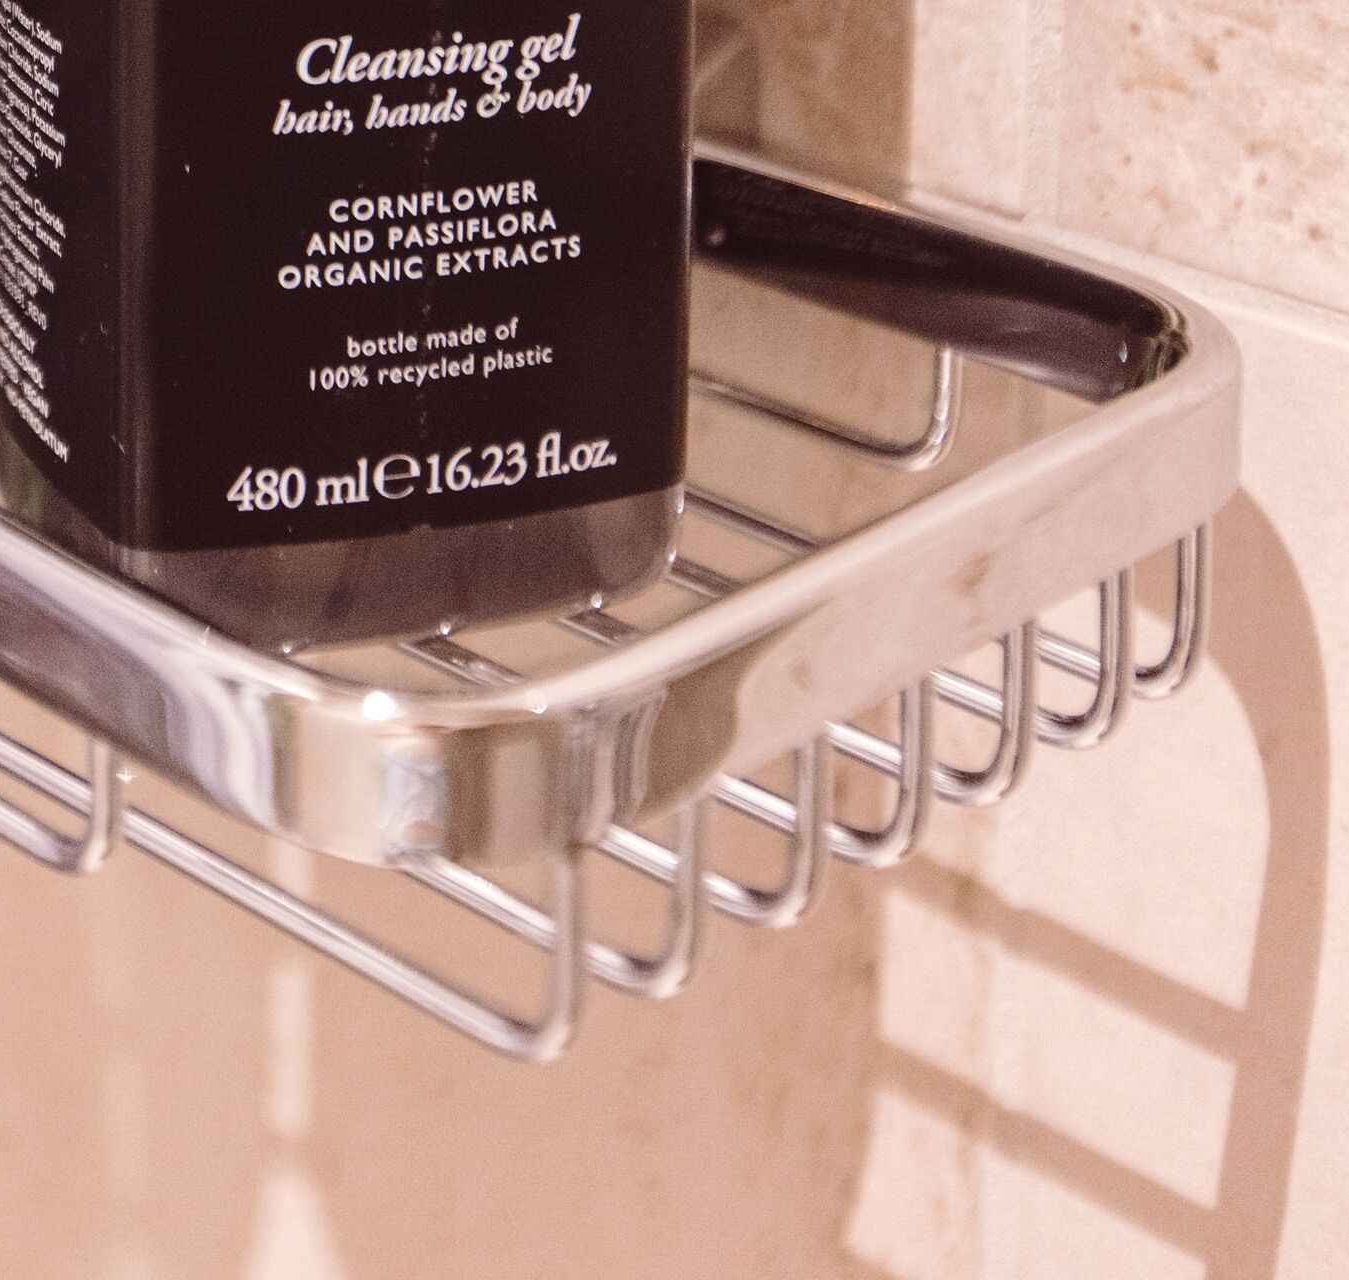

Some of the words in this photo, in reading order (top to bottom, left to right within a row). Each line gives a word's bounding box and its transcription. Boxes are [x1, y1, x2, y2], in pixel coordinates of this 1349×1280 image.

[36, 22, 61, 55] Sodium
[296, 31, 514, 88] Cleansing
[516, 13, 582, 82] gel
[34, 65, 58, 98] Sodium
[34, 88, 54, 118] Citric
[272, 99, 354, 136] hair,
[365, 91, 467, 130] hands
[476, 83, 511, 118] &
[516, 72, 593, 117] body
[31, 107, 65, 148] Potassium
[33, 132, 61, 169] Glyceryl
[328, 179, 539, 224] CORNFLOWER
[305, 228, 375, 257] AND
[387, 207, 557, 252] PASSIFLORA
[277, 255, 425, 290] ORGANIC
[436, 235, 582, 278] EXTRACTS
[346, 333, 418, 359] bottle
[425, 324, 487, 349] made
[494, 316, 519, 342] of
[309, 364, 369, 391] 100%
[377, 354, 475, 389] recycled
[482, 344, 554, 379] plastic
[226, 466, 305, 512] 480
[316, 458, 369, 507] ml
[427, 445, 527, 495] 16.23
[535, 430, 618, 479] fl.oz.
